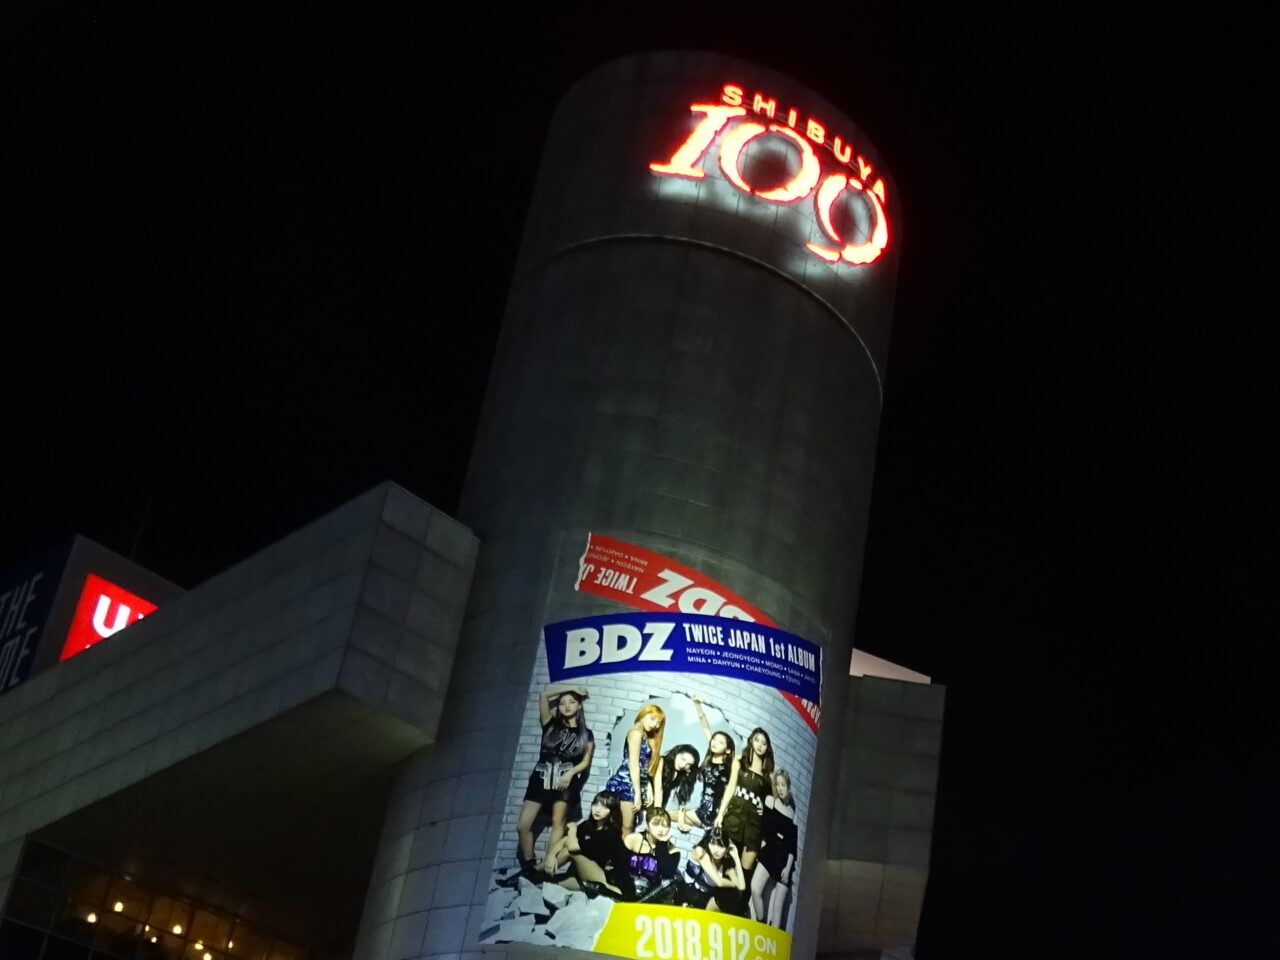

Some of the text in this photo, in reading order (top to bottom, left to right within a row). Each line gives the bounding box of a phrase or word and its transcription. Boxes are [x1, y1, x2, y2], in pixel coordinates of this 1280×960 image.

[723, 84, 886, 202] SHIBUYA
[650, 104, 889, 266] 109
[594, 567, 638, 594] TWICE
[563, 622, 676, 669] BDZ
[683, 623, 816, 673] TWICE JAPAN 1st ALBUM
[686, 647, 716, 656] NAYEON
[687, 655, 707, 663] MINA
[712, 658, 741, 668] DAHYUN
[755, 935, 776, 957] ON
